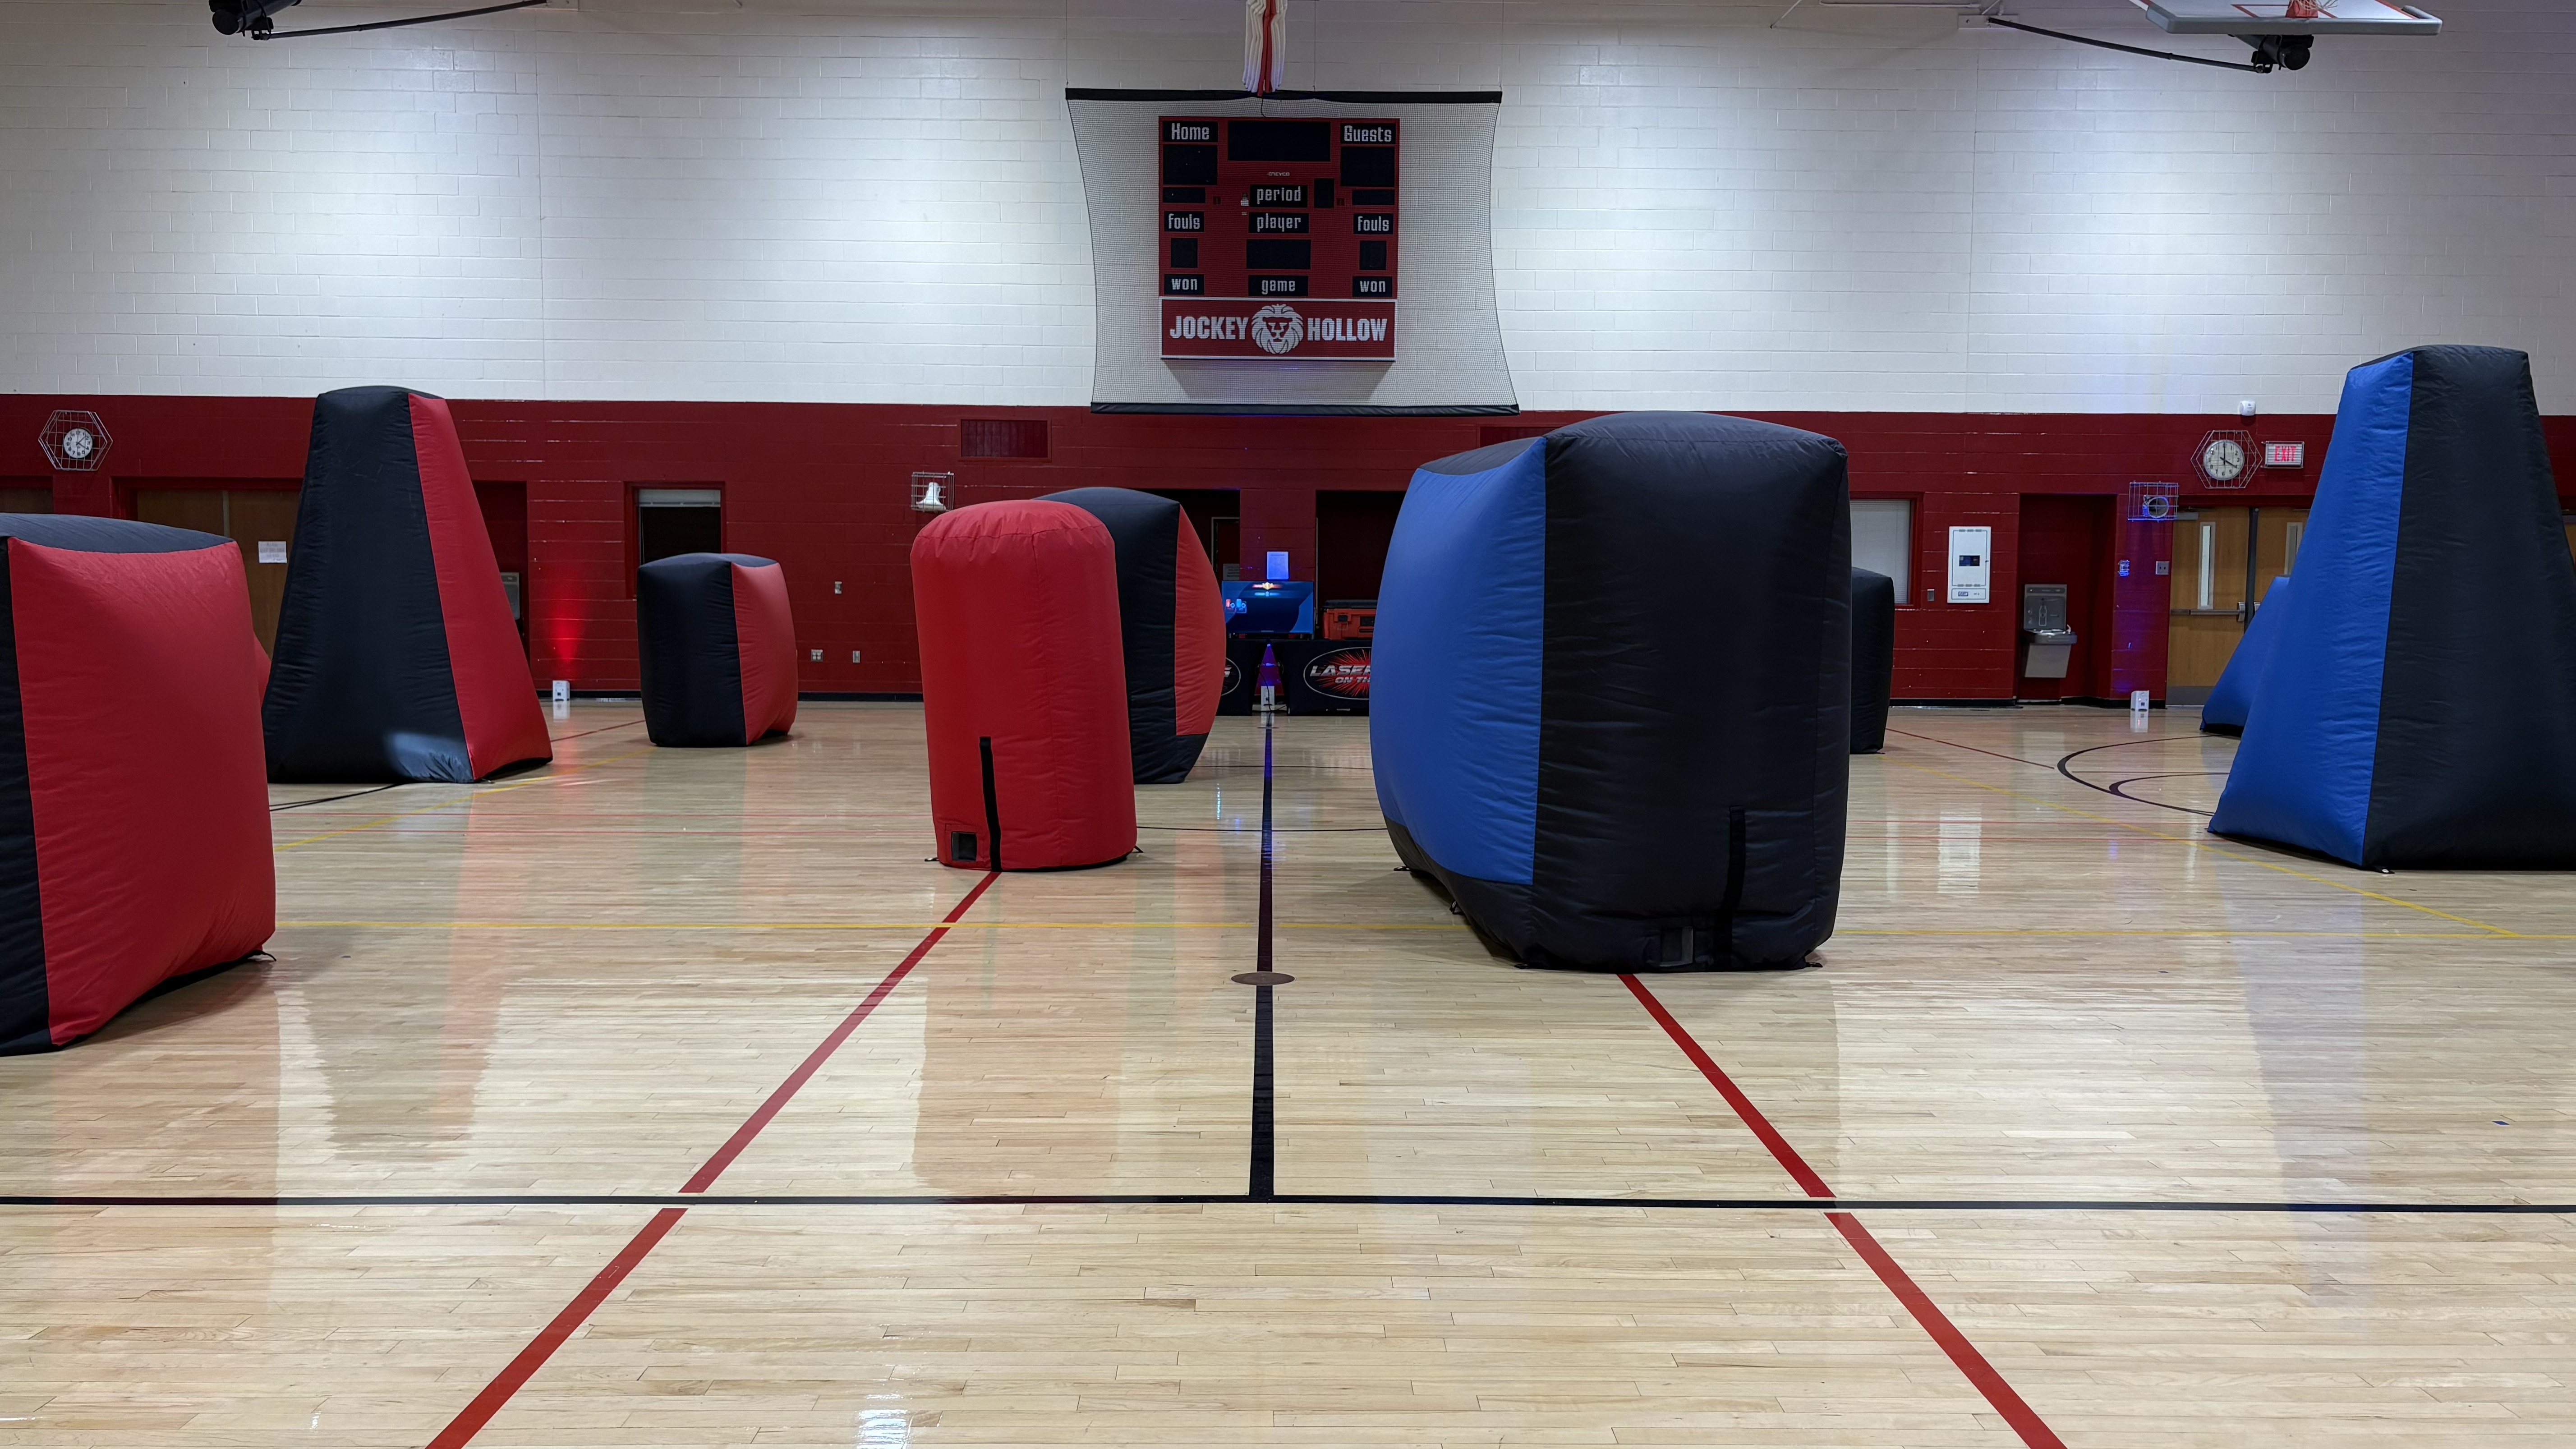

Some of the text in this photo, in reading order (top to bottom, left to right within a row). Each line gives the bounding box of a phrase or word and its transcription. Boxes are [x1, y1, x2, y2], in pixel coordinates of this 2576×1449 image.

[1171, 123, 1210, 140] Home
[1344, 125, 1392, 142] Guests
[1257, 186, 1301, 204] period
[1257, 213, 1301, 232] player
[1171, 279, 1197, 290] won
[1261, 280, 1296, 294] game
[1360, 281, 1386, 292] won
[1170, 316, 1388, 341] JOCKEY HOLLOW
[2274, 446, 2296, 462] EXIT
